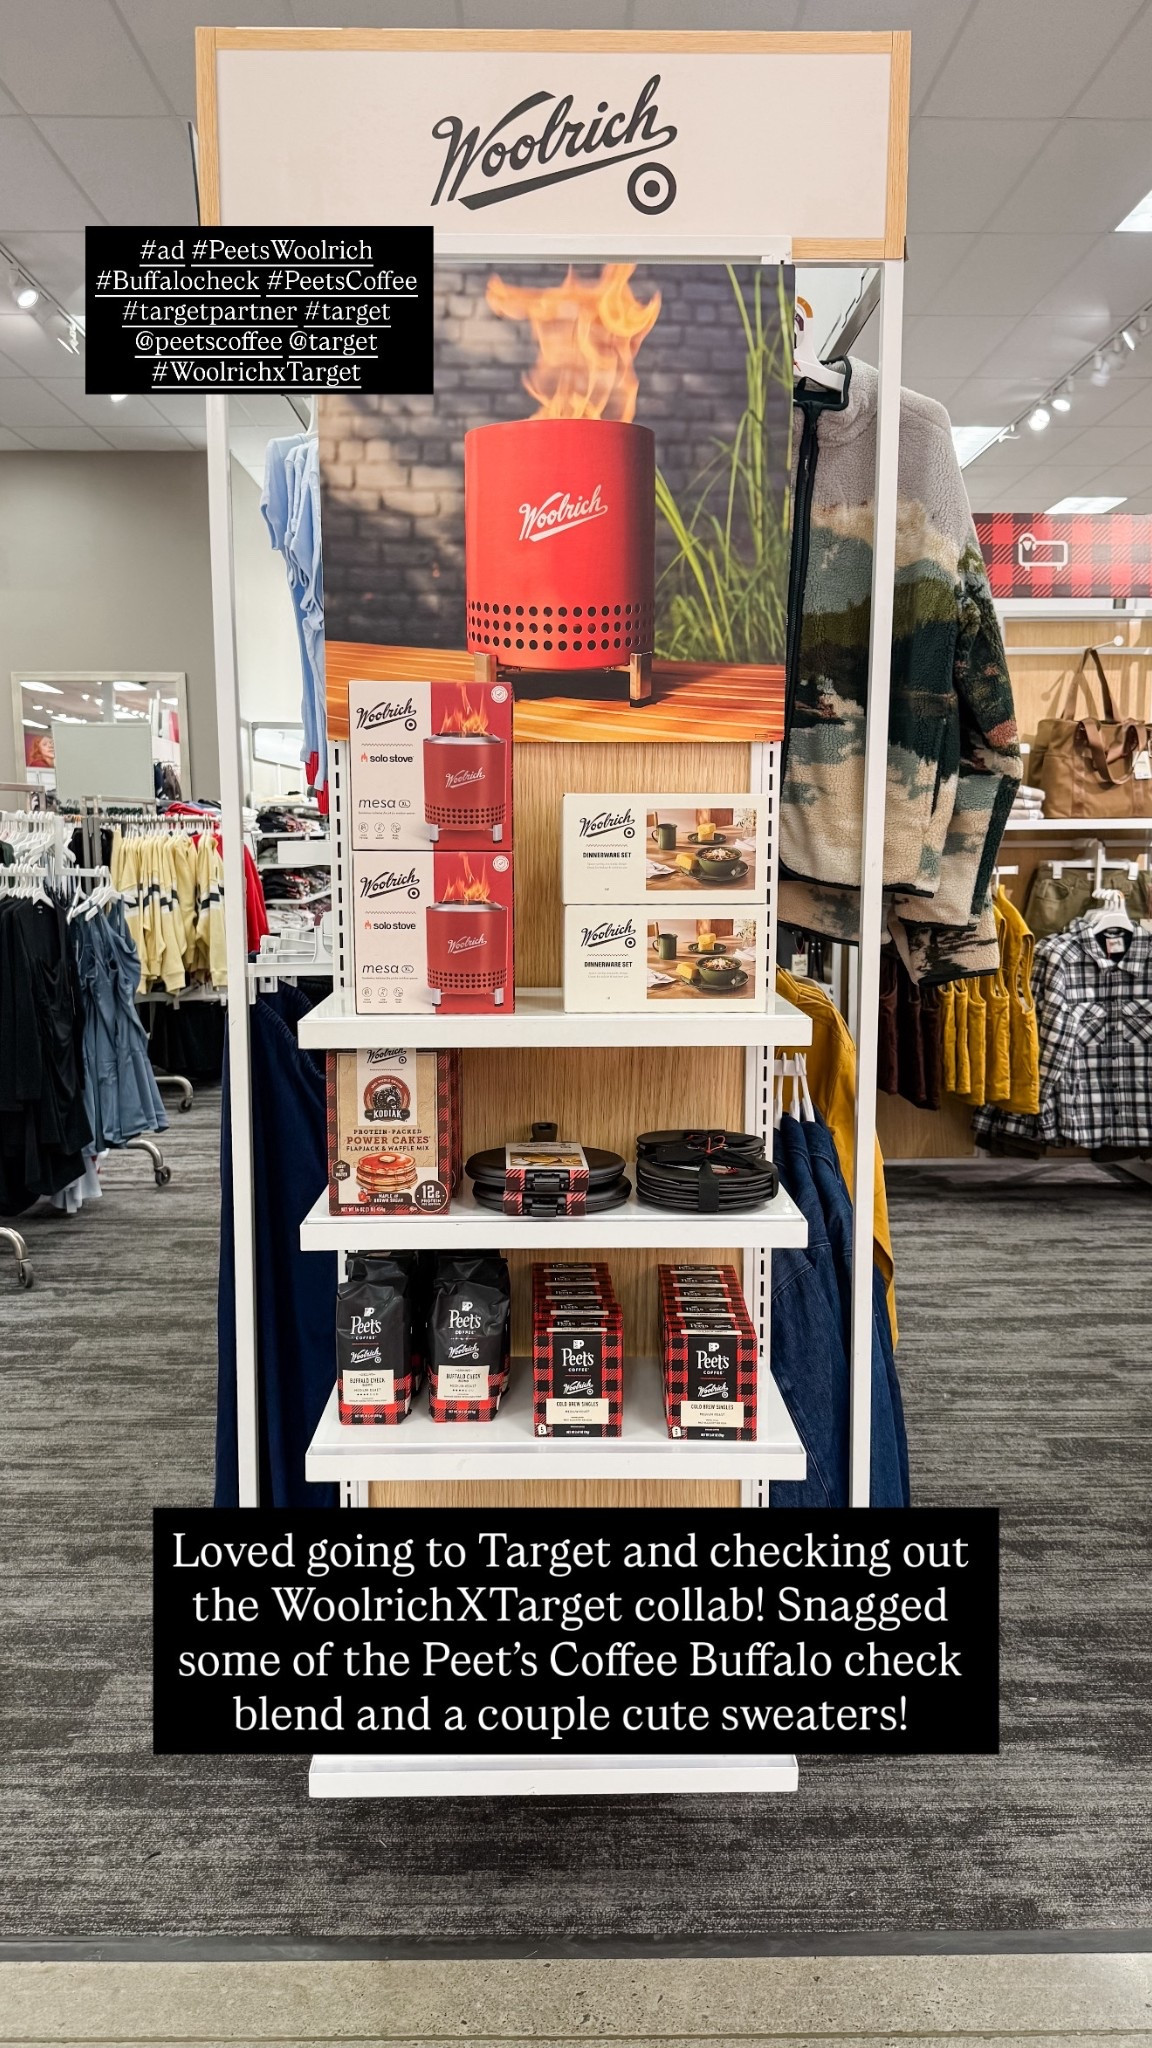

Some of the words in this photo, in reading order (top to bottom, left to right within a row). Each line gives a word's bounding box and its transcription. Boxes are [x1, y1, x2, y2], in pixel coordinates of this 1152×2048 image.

[430, 74, 678, 211] Woolrich
[518, 484, 609, 542] Woolrich
[356, 697, 417, 730] Woolrich
[370, 754, 388, 763] solo
[389, 754, 413, 763] stove
[445, 767, 486, 789] Woolrich
[358, 799, 396, 809] mesa
[579, 808, 636, 838] Woolrich
[360, 867, 420, 899] Woolrich
[373, 921, 391, 930] solo
[392, 921, 416, 930] stove
[580, 918, 637, 948] Woolrich
[447, 933, 488, 954] Woolrich
[362, 964, 399, 974] mesa
[373, 1109, 402, 1119] KODIAK
[346, 1136, 388, 1145] POWER
[392, 1136, 430, 1145] CAKES
[560, 1347, 595, 1367] Peet's
[695, 1350, 730, 1370] Peet's
